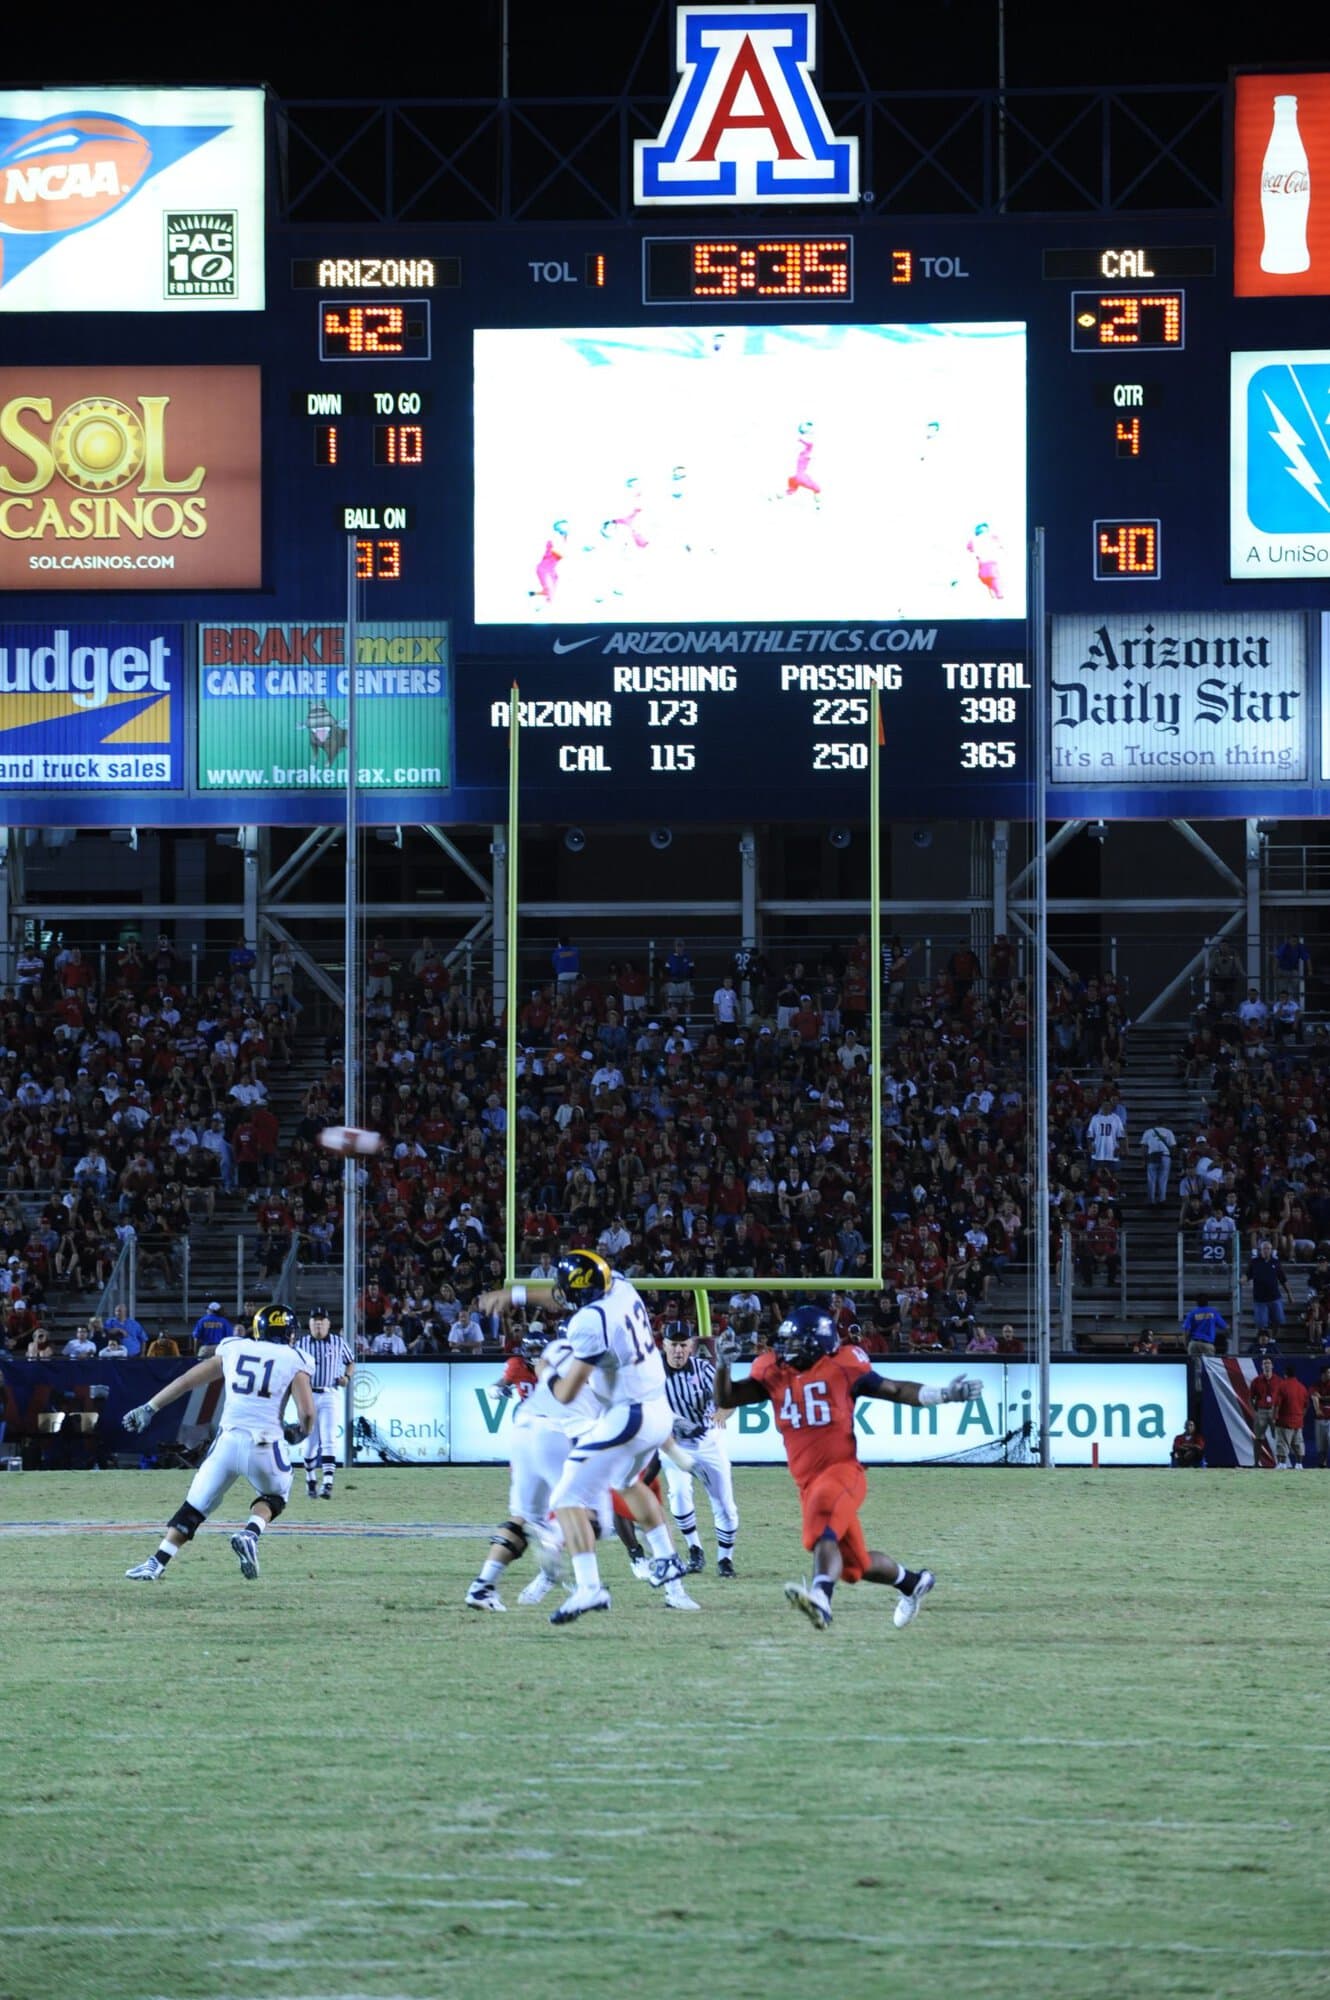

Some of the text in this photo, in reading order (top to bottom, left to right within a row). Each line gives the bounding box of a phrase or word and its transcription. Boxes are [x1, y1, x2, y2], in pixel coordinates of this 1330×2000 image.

[6, 161, 121, 204] NCAA
[168, 233, 233, 253] PAC
[169, 254, 233, 281] 10
[318, 259, 435, 287] ARIZONA
[528, 262, 577, 283] TOL
[596, 255, 605, 287] 1
[693, 243, 848, 296] 5:35
[892, 251, 912, 283] 3
[920, 257, 969, 278] TOL
[1101, 250, 1155, 278] CAL
[169, 281, 233, 294] FOOTBALL
[325, 308, 403, 351] 42
[1100, 298, 1180, 343] 27
[307, 394, 342, 416] DWN
[374, 394, 421, 415] TO GO
[1113, 384, 1144, 407] QTR
[0, 396, 207, 494] SOL
[328, 427, 337, 464] 1
[387, 427, 423, 464] 10
[1116, 418, 1140, 456] 4
[0, 497, 208, 540] CASINOS
[344, 507, 407, 530] BALL ON
[29, 555, 175, 571] SOLCASINOS.COM
[1100, 528, 1155, 572] 40
[1246, 544, 1329, 563] A UniSo
[203, 627, 346, 666] BRAKE
[602, 629, 938, 655] ARIZONAATHLETICS.COM
[1079, 624, 1271, 672] Arizona
[0, 629, 171, 709] udget
[207, 669, 442, 696] CAR CARE CENTERS
[613, 663, 1031, 693] RUSHING PASSING TOTAL
[490, 697, 1016, 728] ARIZONA 173 225 398
[1052, 678, 1300, 736] Daily Star
[0, 758, 166, 778] and truck sales
[558, 742, 1016, 772] CAL 115 250 365
[1055, 744, 1299, 768] It's a Tucson thing.
[1203, 1246, 1225, 1259] 29
[568, 1267, 593, 1289] Cal
[268, 1310, 288, 1327] Cal
[231, 1354, 276, 1399] 51
[779, 1380, 832, 1430] 46
[956, 1389, 1165, 1439] Arizona
[390, 1418, 446, 1438] Bank
